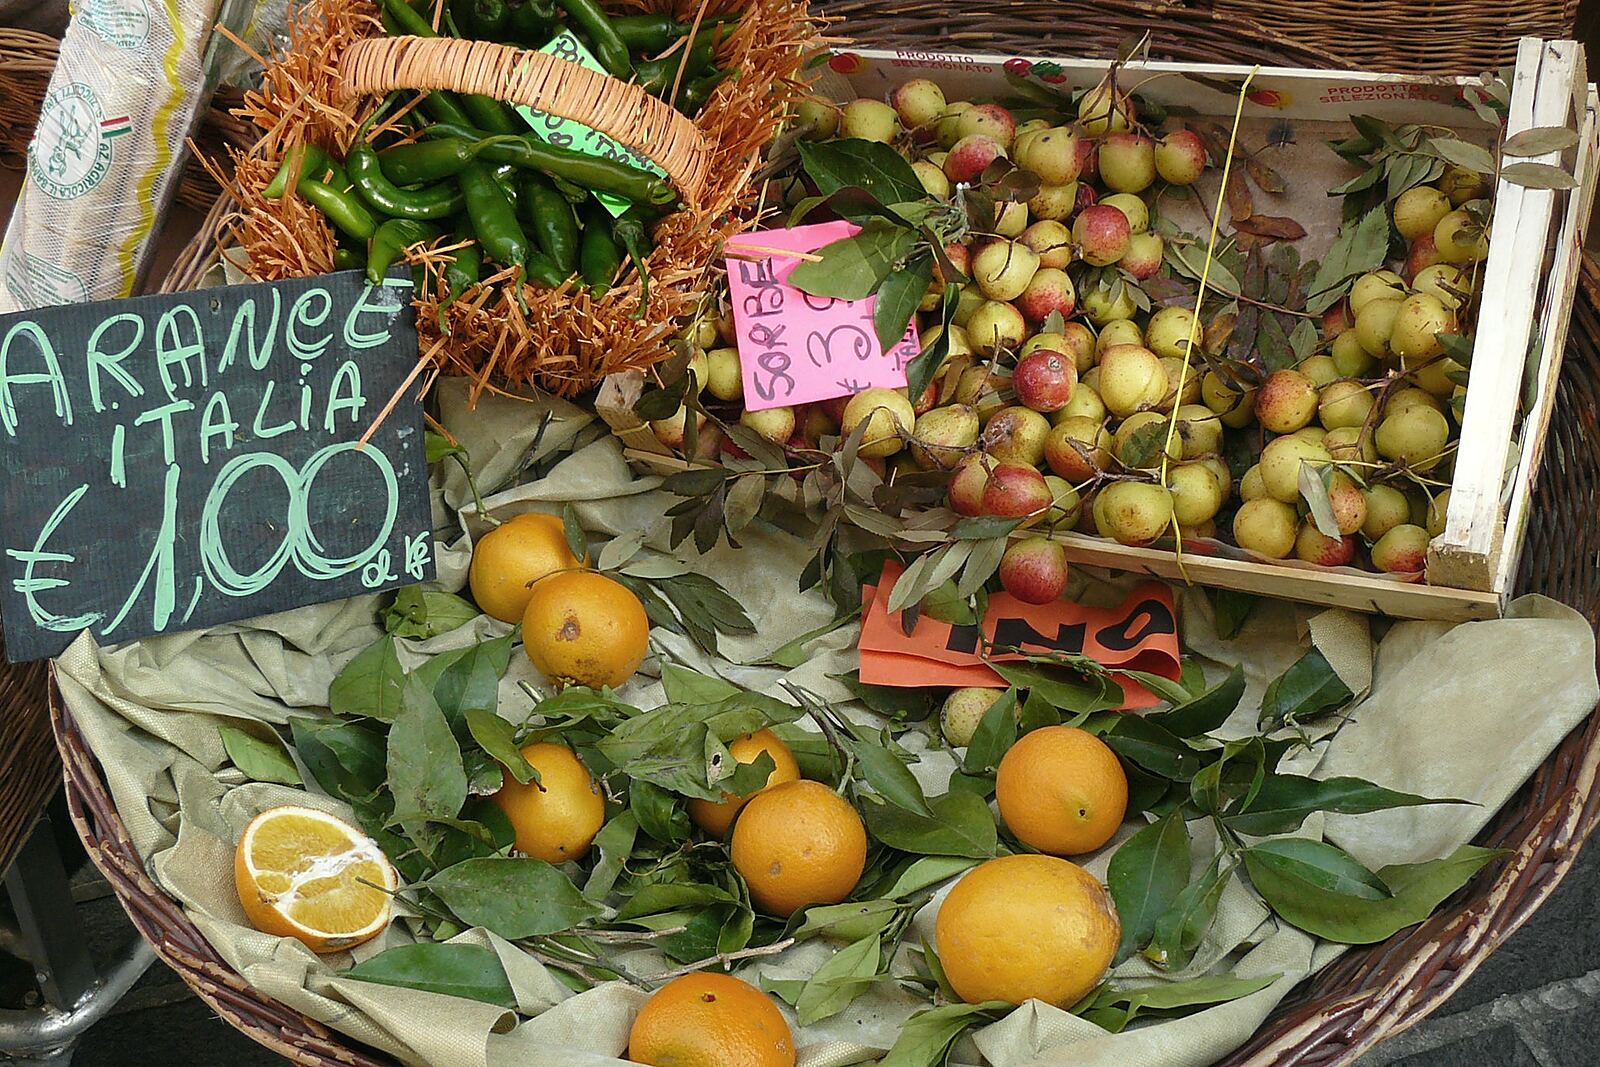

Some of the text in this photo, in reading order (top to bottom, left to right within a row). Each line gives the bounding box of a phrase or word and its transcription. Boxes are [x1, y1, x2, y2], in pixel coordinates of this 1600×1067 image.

[895, 50, 975, 64] PRODOTTO
[891, 59, 993, 73] SELEZIONATO
[1327, 83, 1421, 95] PRODOTTO
[1319, 91, 1440, 104] SELEZIONATO
[60, 162, 105, 198] AGRICOLA
